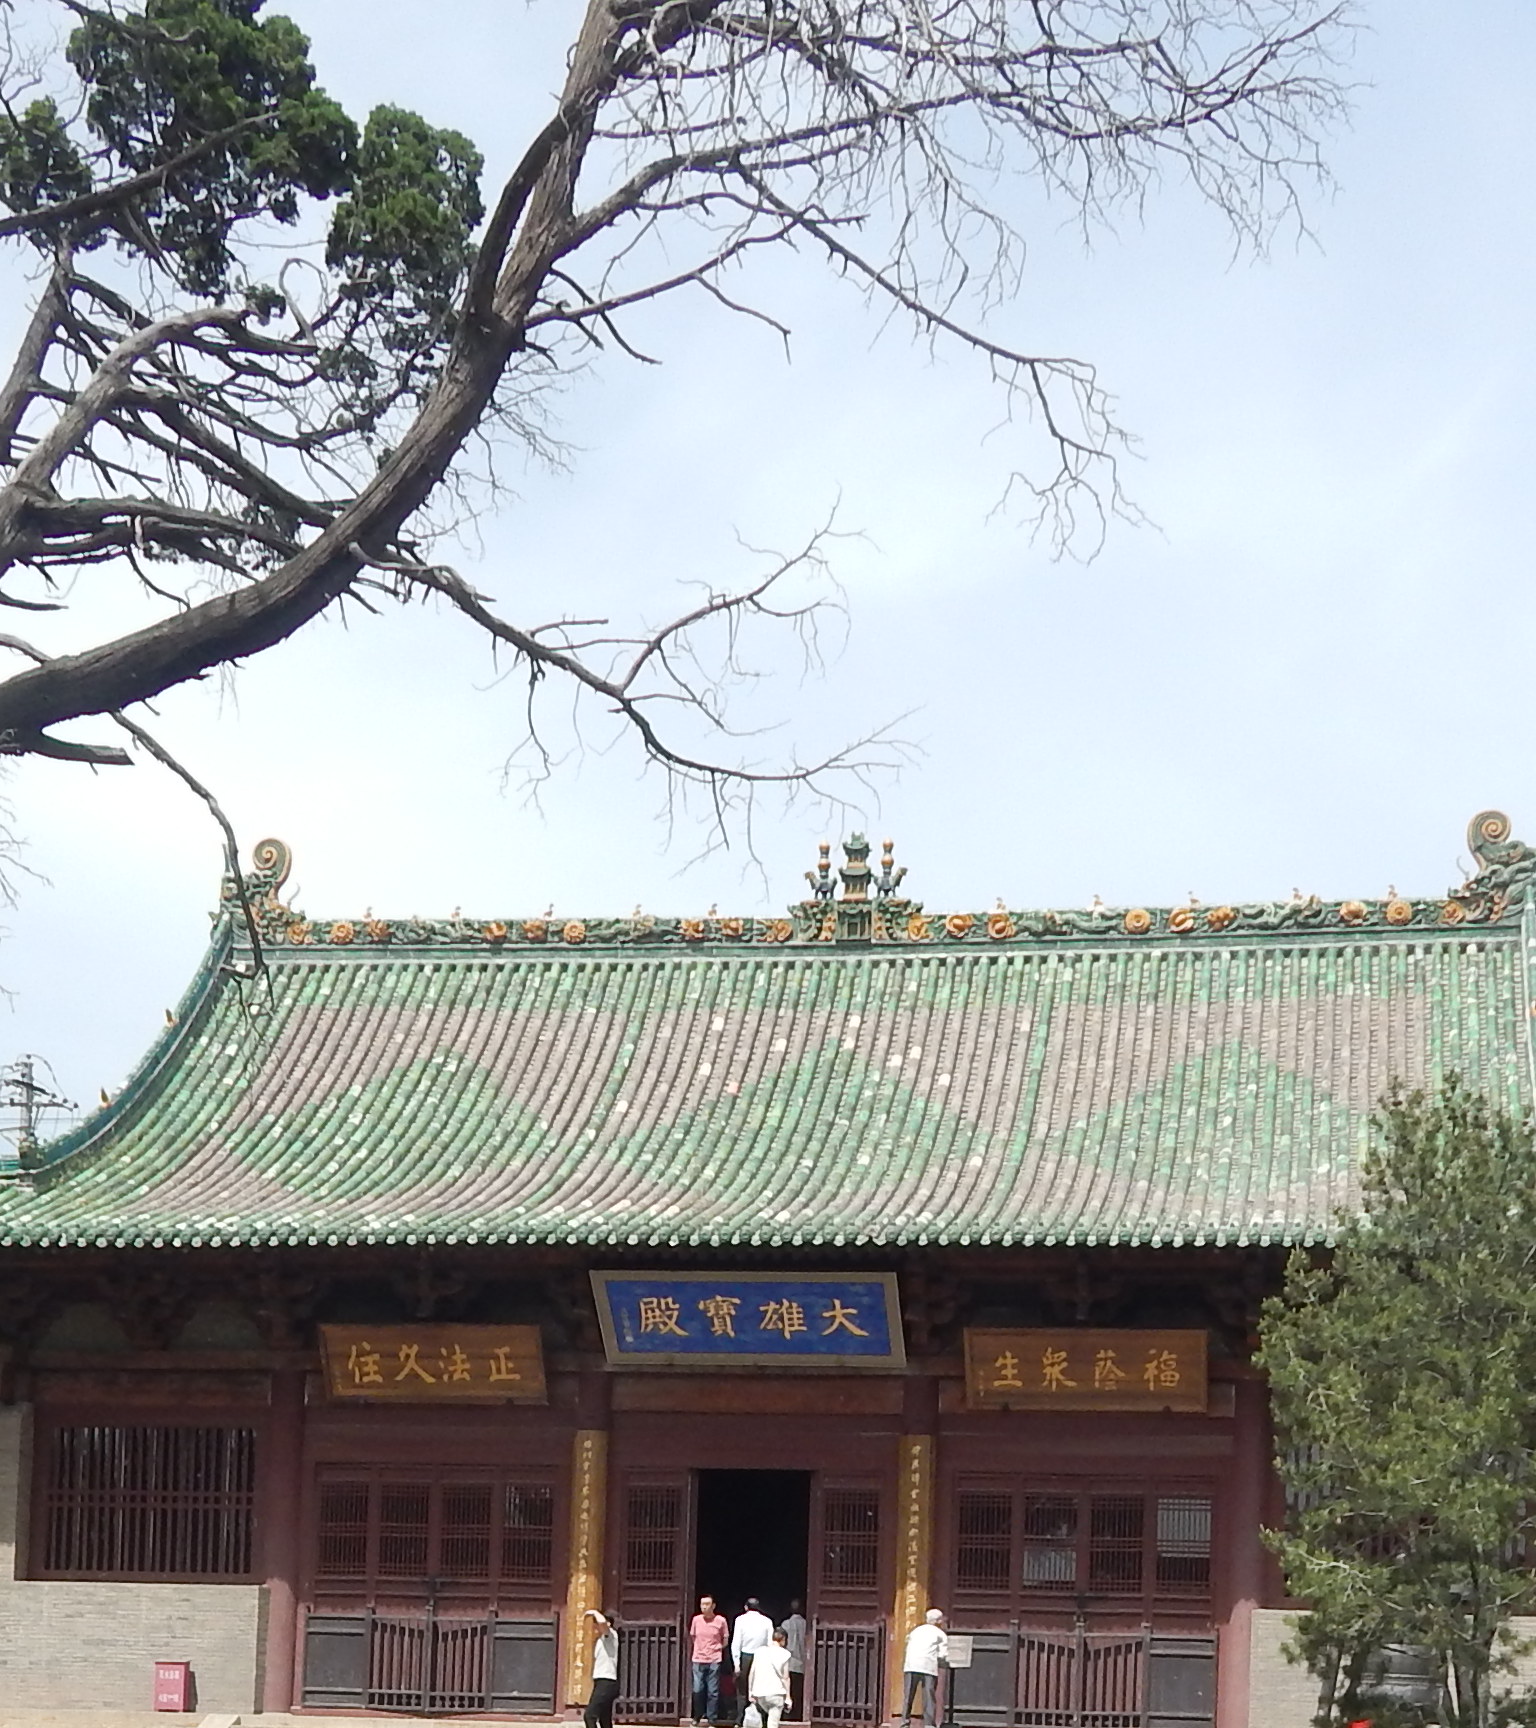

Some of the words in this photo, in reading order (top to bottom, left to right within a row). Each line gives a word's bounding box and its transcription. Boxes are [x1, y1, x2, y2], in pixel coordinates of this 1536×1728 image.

[638, 1294, 871, 1341] 大雄寶殿
[347, 1340, 522, 1384] 正法久住
